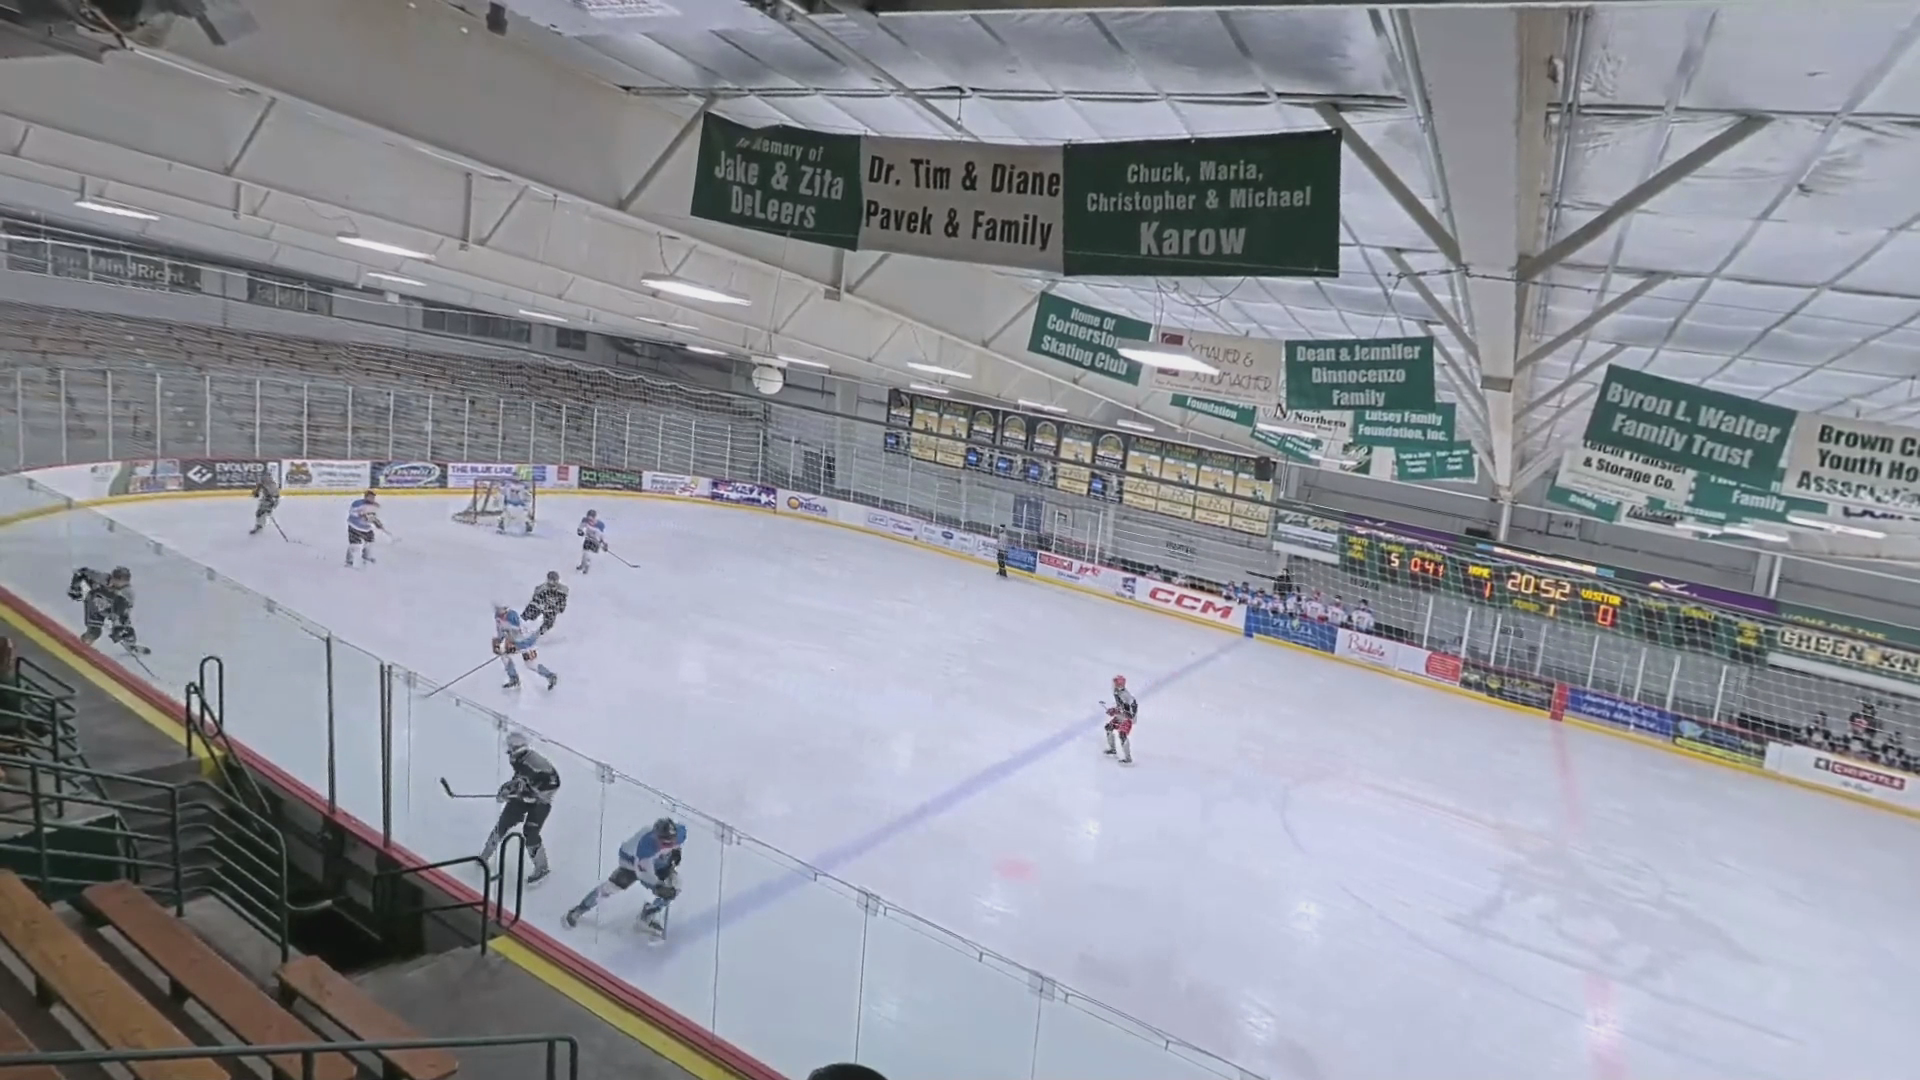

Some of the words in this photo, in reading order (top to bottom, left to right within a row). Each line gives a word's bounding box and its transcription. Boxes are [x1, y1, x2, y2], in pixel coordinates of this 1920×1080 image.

[808, 146, 824, 162] of
[714, 150, 760, 186] Jake
[771, 161, 789, 191] &
[799, 165, 844, 200] Zita
[868, 155, 901, 186] Dr.
[910, 158, 950, 190] Tim
[961, 161, 978, 191] &
[991, 163, 1061, 197] Diane
[1127, 162, 1191, 184] Chuck,
[1200, 160, 1264, 182] Maria,
[731, 185, 816, 228] DeLeers
[1087, 190, 1196, 213] Christopher
[1205, 189, 1219, 209] &
[1229, 186, 1312, 208] Michael
[865, 199, 933, 236] Pavek
[944, 207, 960, 238] &
[972, 210, 1053, 251] Family
[1140, 221, 1246, 256] Karow
[1070, 307, 1101, 327] Home
[1103, 316, 1117, 331] Of
[1047, 314, 1121, 350] Cornersto
[1041, 335, 1092, 368] Skating
[1094, 351, 1129, 376] Club
[1296, 346, 1336, 362] Dean
[1339, 346, 1351, 361] &
[1354, 344, 1421, 361] Jennifer
[1186, 397, 1238, 420] Foundation
[1332, 389, 1386, 408] Family
[1294, 411, 1347, 428] Northern
[1404, 410, 1443, 426] Family
[1606, 381, 1671, 421] Byron
[1674, 398, 1693, 423] L.
[1697, 405, 1781, 445] Walter
[1427, 428, 1449, 441] Inc.
[1611, 412, 1689, 453] Family
[1693, 433, 1754, 470] Trust
[1818, 424, 1895, 454] Brown
[215, 463, 264, 473] EVOLVED
[451, 465, 469, 474] THE
[470, 466, 492, 475] BLUE
[1583, 456, 1593, 468] &
[1596, 458, 1652, 484] Storage
[1654, 474, 1676, 491] Co.
[1818, 449, 1882, 478] Youth
[1732, 490, 1786, 513] Family
[1390, 553, 1400, 568] 5
[1468, 564, 1492, 578] HOME
[1507, 572, 1571, 601] 20:52
[1581, 589, 1623, 606] VISITOR
[1149, 587, 1233, 619] CCM
[1597, 605, 1613, 626] 0
